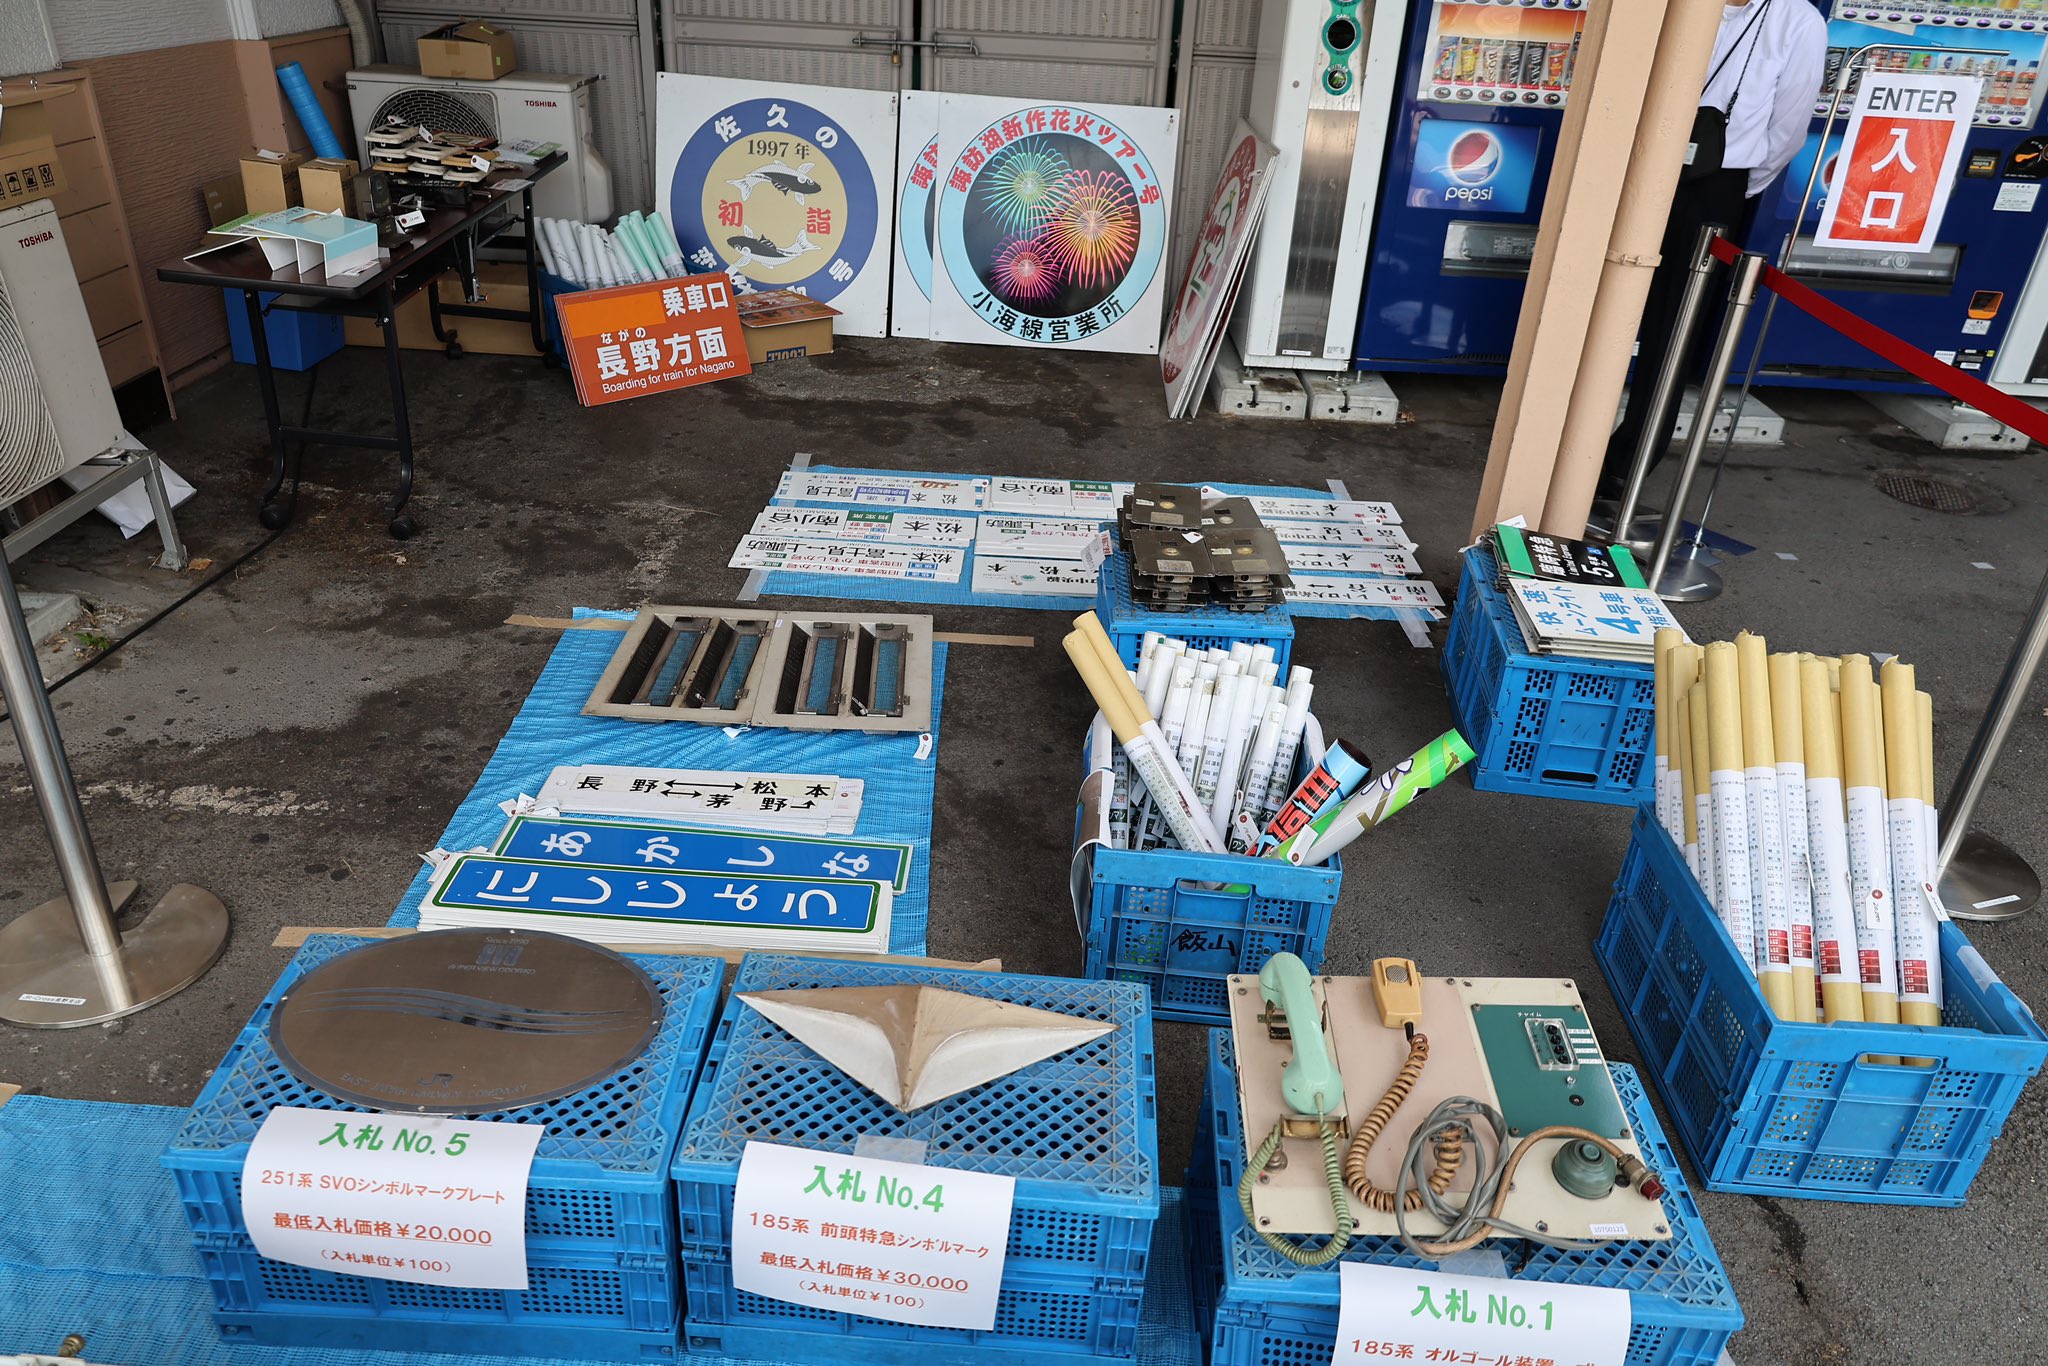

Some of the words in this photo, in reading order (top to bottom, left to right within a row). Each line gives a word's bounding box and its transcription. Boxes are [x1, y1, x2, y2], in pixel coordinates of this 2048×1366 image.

[524, 100, 557, 108] TOSHIBA
[1867, 87, 1957, 114] ENTER
[714, 103, 839, 149] 佐久の
[1445, 186, 1494, 202] pepsi
[1859, 127, 1918, 229] 入口
[18, 230, 55, 248] TOSHIBA
[662, 281, 730, 317] 乗車口
[972, 290, 1125, 341] 小海線営業所
[600, 327, 647, 344] ながの
[596, 326, 729, 380] 長野方面
[602, 376, 648, 394] Boarding
[648, 373, 662, 386] for
[662, 370, 684, 383] train
[685, 367, 699, 379] for
[699, 360, 735, 375] Nagano
[805, 485, 854, 498] 富士見
[999, 483, 1065, 496] 南小谷
[767, 511, 840, 527] 南小谷
[902, 520, 964, 535] 松本
[828, 546, 886, 559] 富士見
[911, 551, 953, 564] 松本
[1521, 588, 1566, 626] 快速
[1549, 584, 1600, 637] ムーンライト
[1632, 594, 1672, 627] 指定席
[576, 775, 661, 794] 長野
[750, 780, 832, 799] 松本
[705, 793, 790, 813] 茅野
[540, 829, 871, 878] あかしな
[1170, 928, 1237, 957] 飯山
[318, 1121, 386, 1153] 入札
[391, 1128, 470, 1157] No.5
[261, 1169, 313, 1190] 251系
[320, 1174, 506, 1205] SVOシンボルマークプレート
[803, 1164, 867, 1203] 入札
[876, 1175, 945, 1213] No.4
[749, 1211, 811, 1235] 185系
[820, 1221, 990, 1260] 前頭特急シンボルマーク
[1410, 1284, 1477, 1324] 入札
[1487, 1293, 1554, 1331] No.1
[1351, 1338, 1415, 1360] 185系
